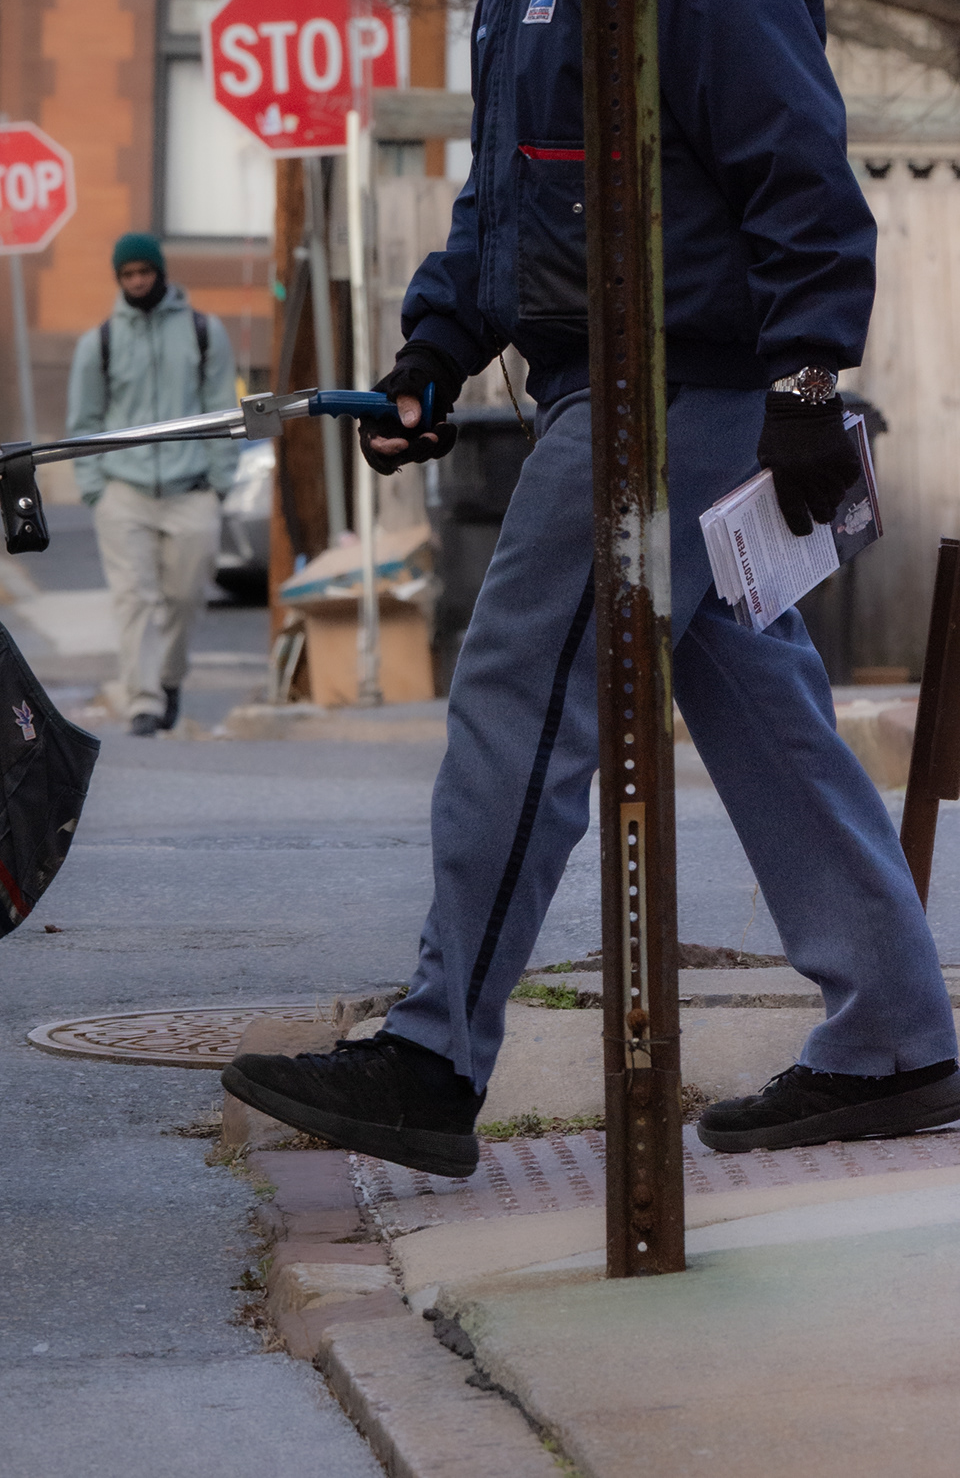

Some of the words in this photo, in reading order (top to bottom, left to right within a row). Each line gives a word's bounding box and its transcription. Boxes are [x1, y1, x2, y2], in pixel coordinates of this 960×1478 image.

[219, 17, 389, 98] STOP
[733, 528, 747, 559] PERRY
[741, 558, 755, 586] SCOTT
[749, 586, 763, 616] ABOUT
